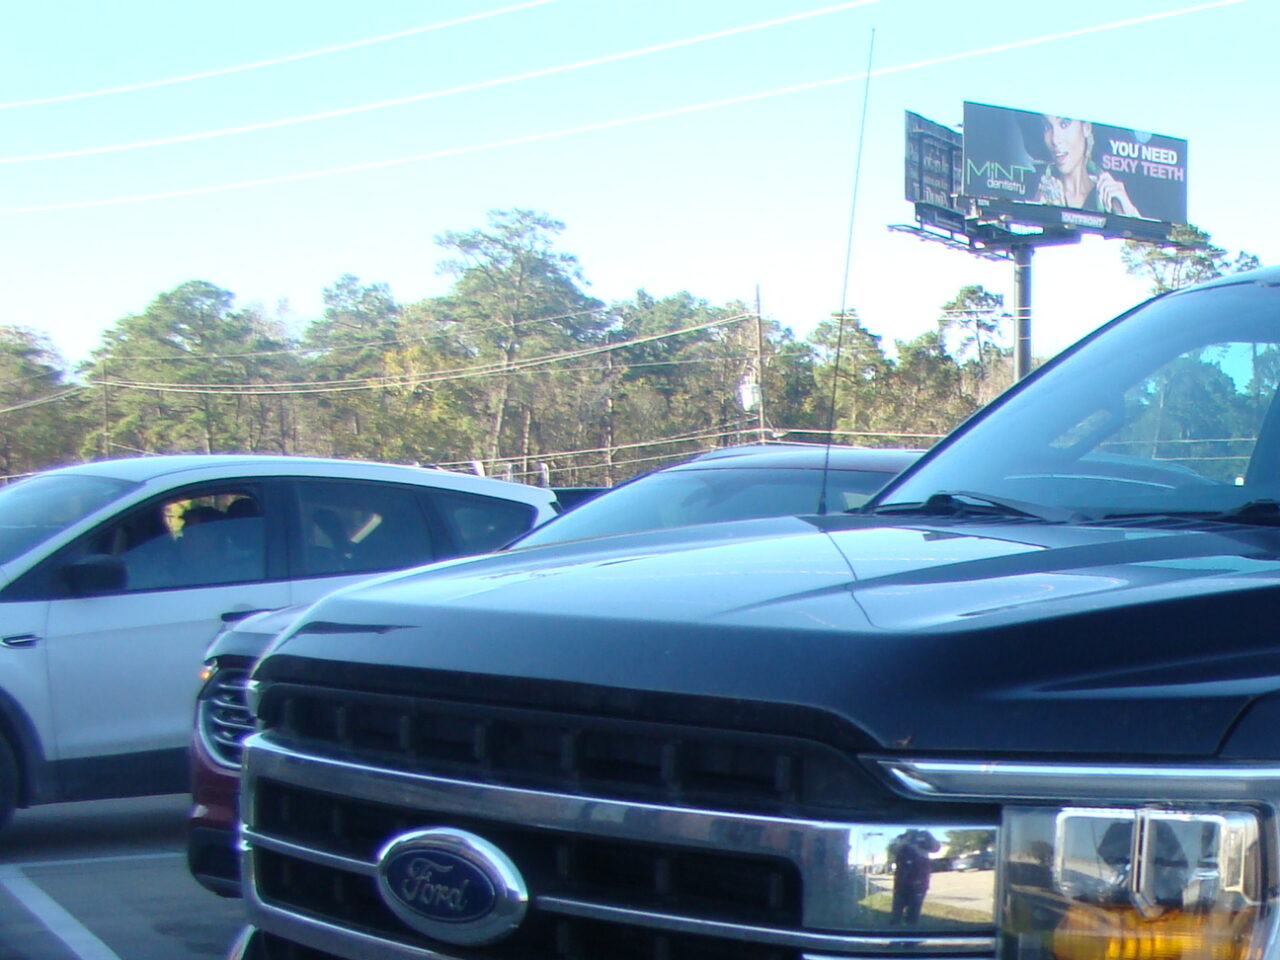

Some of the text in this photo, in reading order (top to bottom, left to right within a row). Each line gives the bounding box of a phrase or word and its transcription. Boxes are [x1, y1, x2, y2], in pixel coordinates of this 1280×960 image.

[1110, 140, 1178, 165] YOU NEED
[967, 158, 1036, 185] MINT
[1102, 155, 1184, 182] SEXY TEETH
[987, 178, 1026, 195] dentistry
[402, 857, 470, 912] Ford
